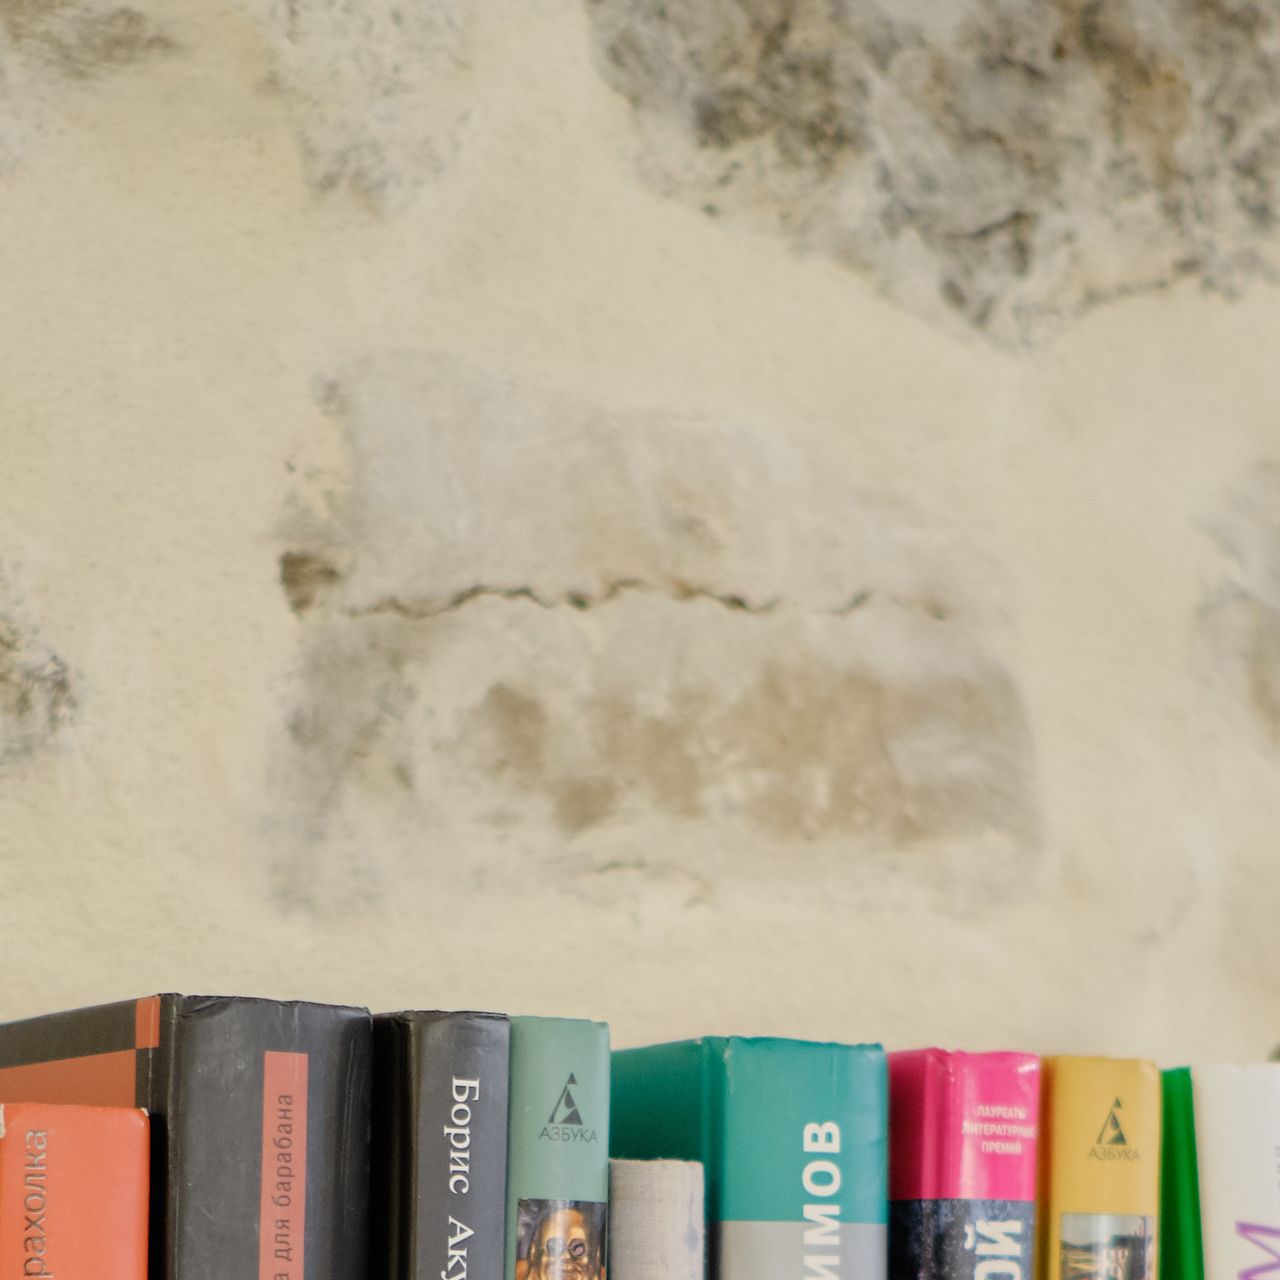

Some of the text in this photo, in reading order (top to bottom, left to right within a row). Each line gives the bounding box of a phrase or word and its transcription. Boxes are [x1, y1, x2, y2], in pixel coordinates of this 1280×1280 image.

[976, 1105, 1026, 1119] ЛАУРЕАТЫ
[443, 1075, 480, 1194] Борис
[538, 1125, 599, 1142] АЗБУКА
[272, 1093, 296, 1208] барабана
[1088, 1148, 1140, 1162] АЗБУКА
[273, 1219, 293, 1262] для
